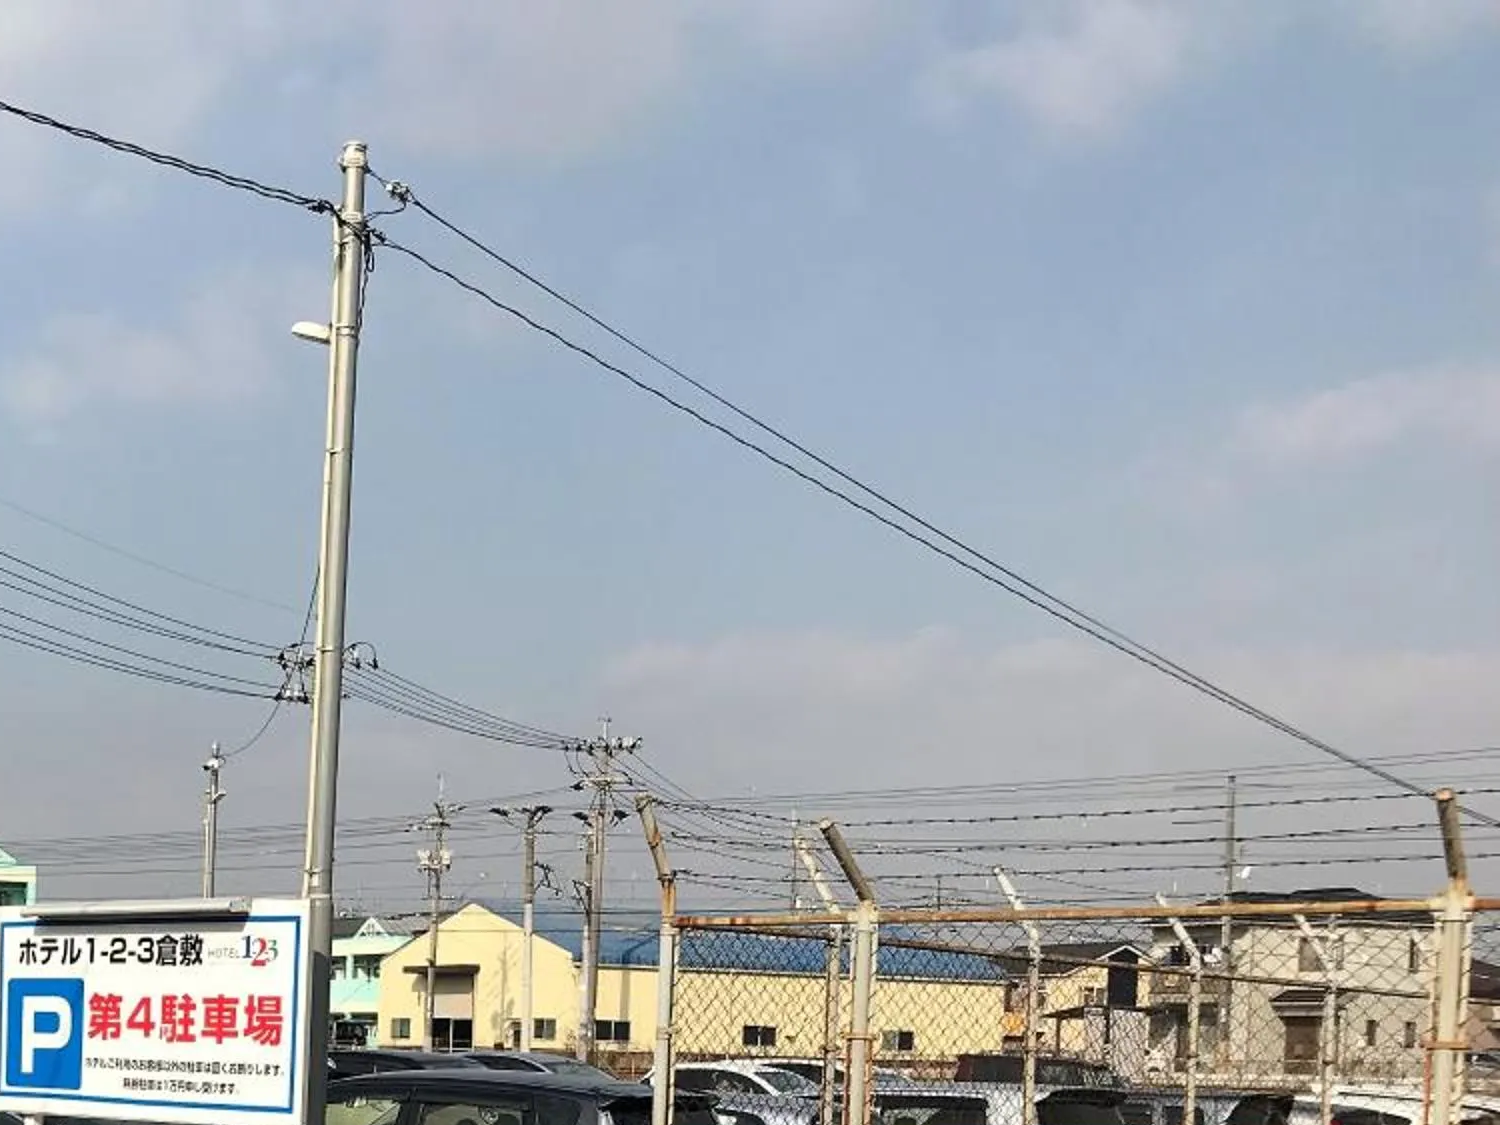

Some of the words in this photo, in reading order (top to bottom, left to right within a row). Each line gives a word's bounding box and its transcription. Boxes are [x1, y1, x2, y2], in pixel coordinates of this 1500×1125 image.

[19, 933, 204, 967] ホテル1-2-3倉敷
[20, 994, 73, 1075] P
[88, 992, 285, 1047] 第4駐車場
